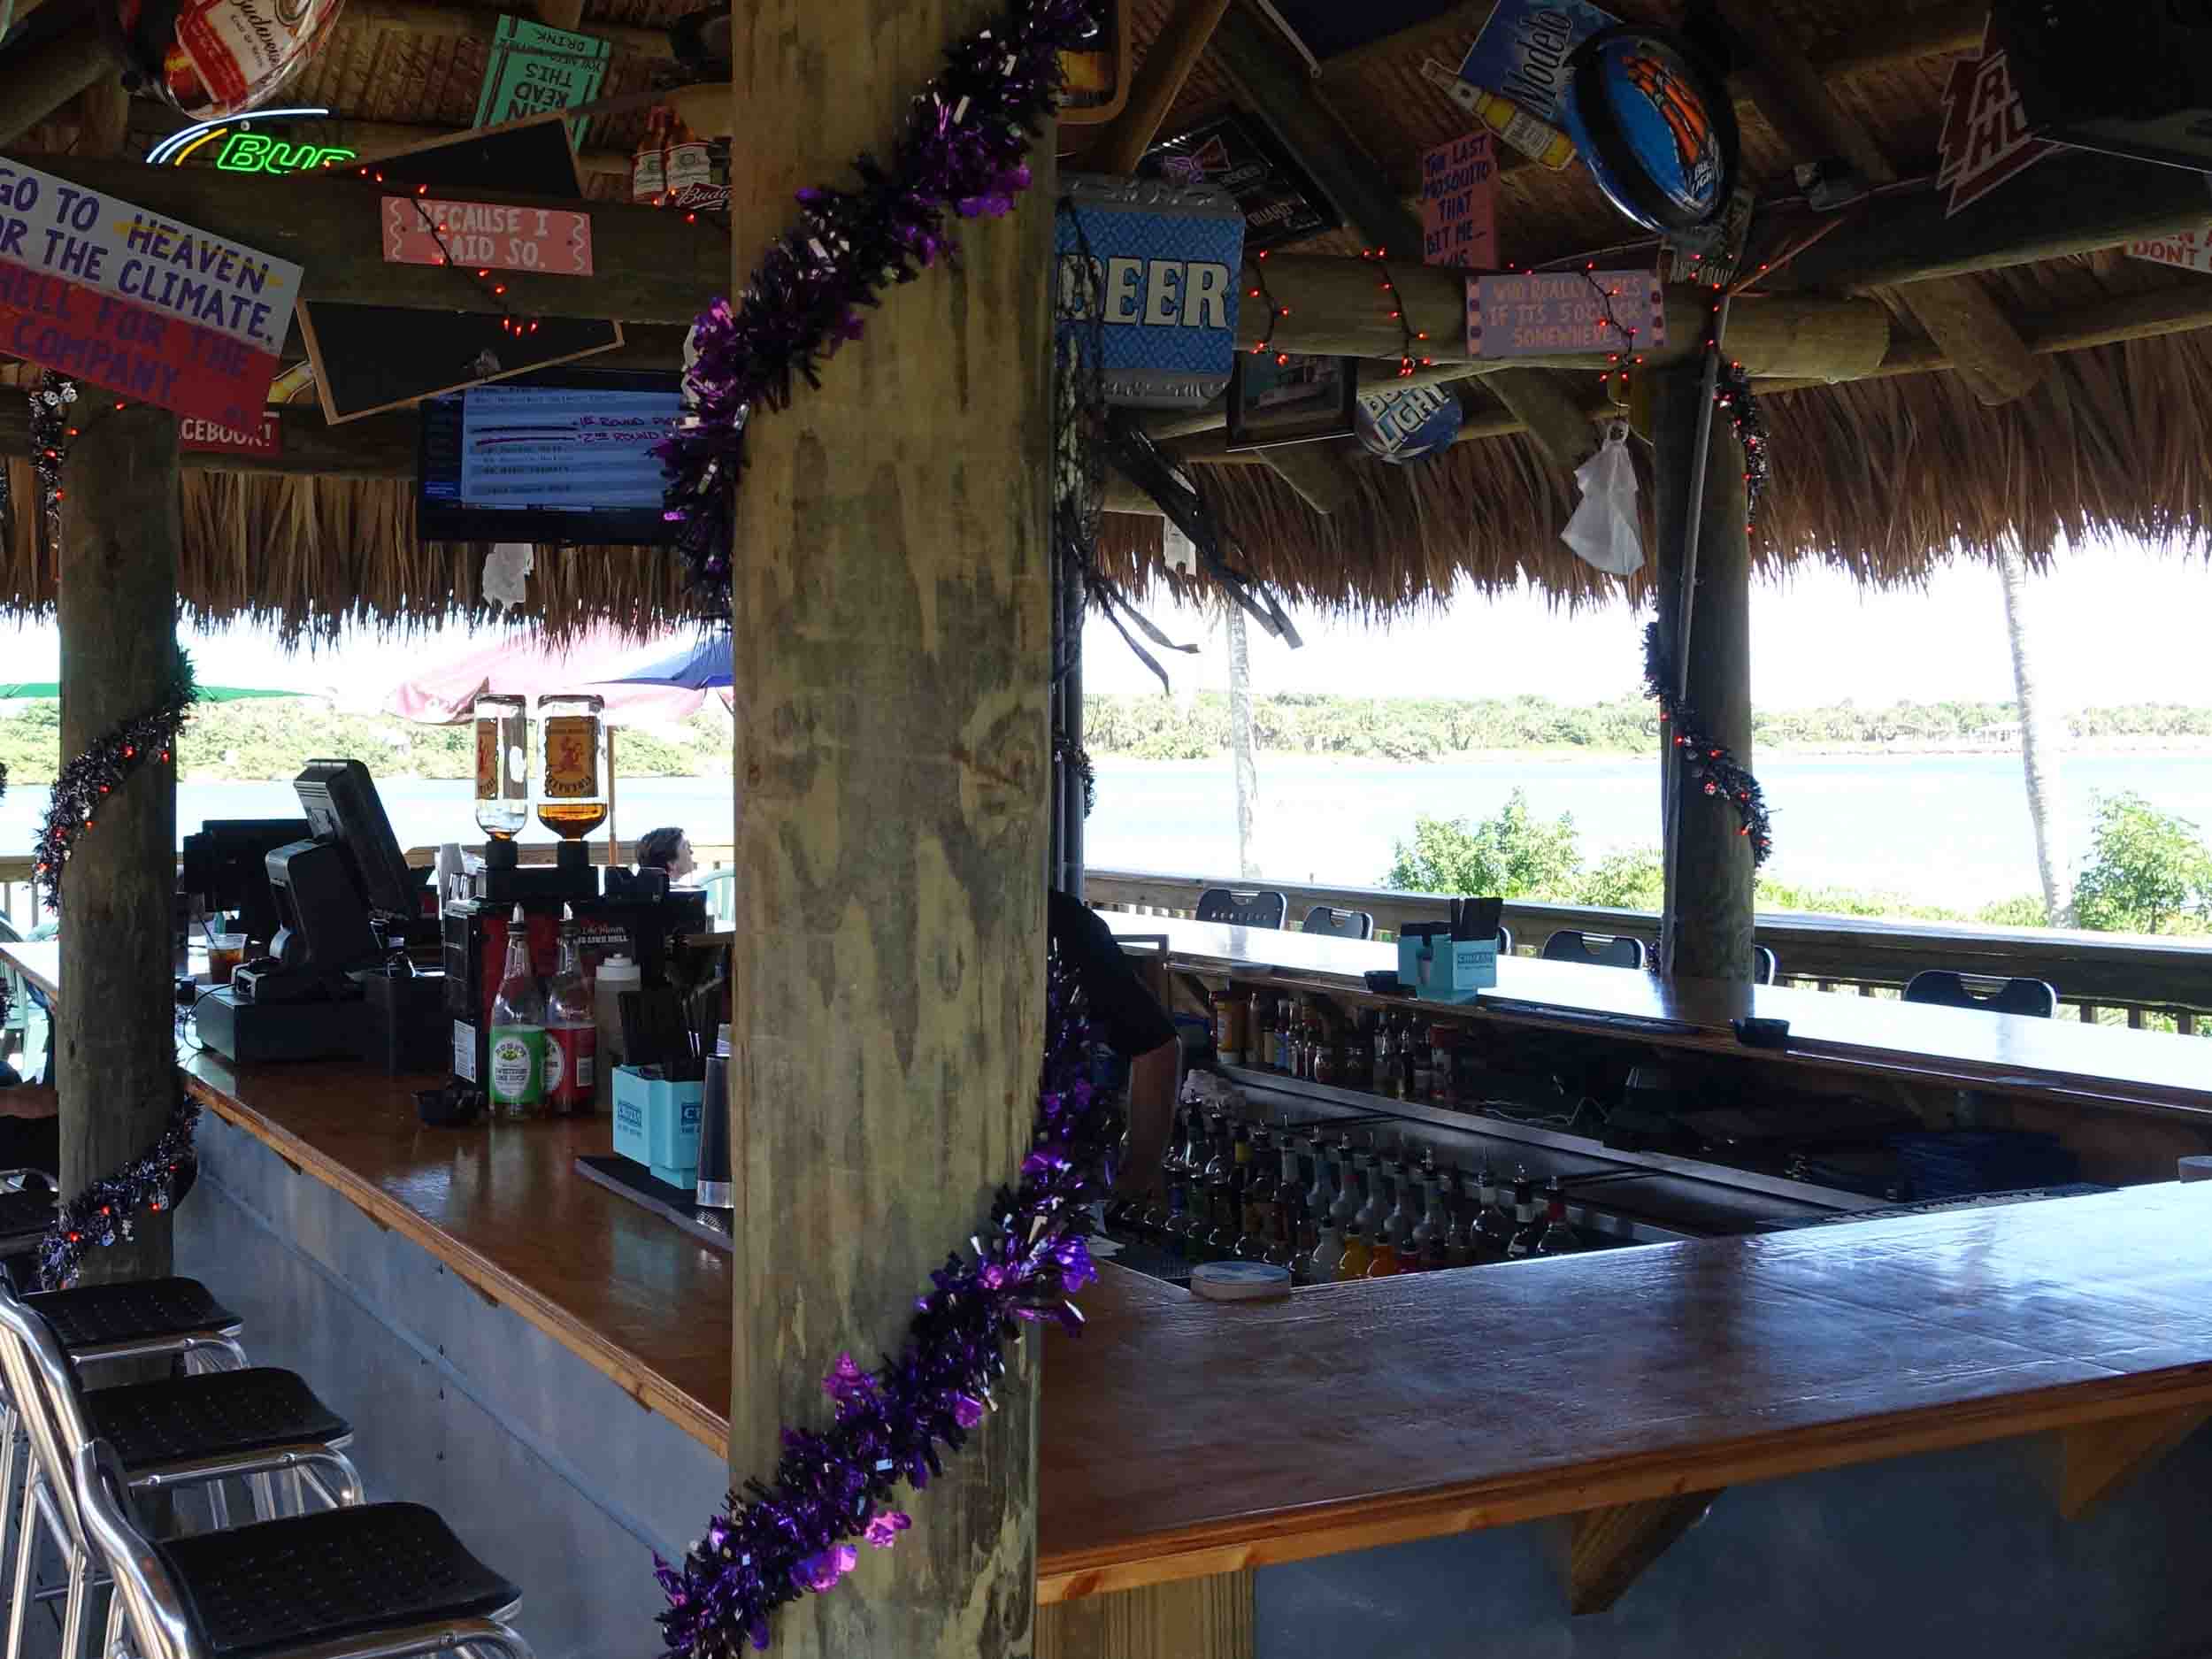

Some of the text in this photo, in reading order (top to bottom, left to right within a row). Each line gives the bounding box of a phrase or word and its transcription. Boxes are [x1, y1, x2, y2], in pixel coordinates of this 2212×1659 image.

[526, 63, 572, 88] THIS
[537, 30, 586, 53] DRINK
[1502, 11, 1572, 116] Modelo
[57, 187, 100, 232] TO
[127, 213, 270, 295] HEAVEN
[417, 202, 549, 236] BECAUSE I
[42, 228, 108, 282] THE
[118, 259, 274, 346] CLIMATE.
[1373, 382, 1452, 453] LIGHT
